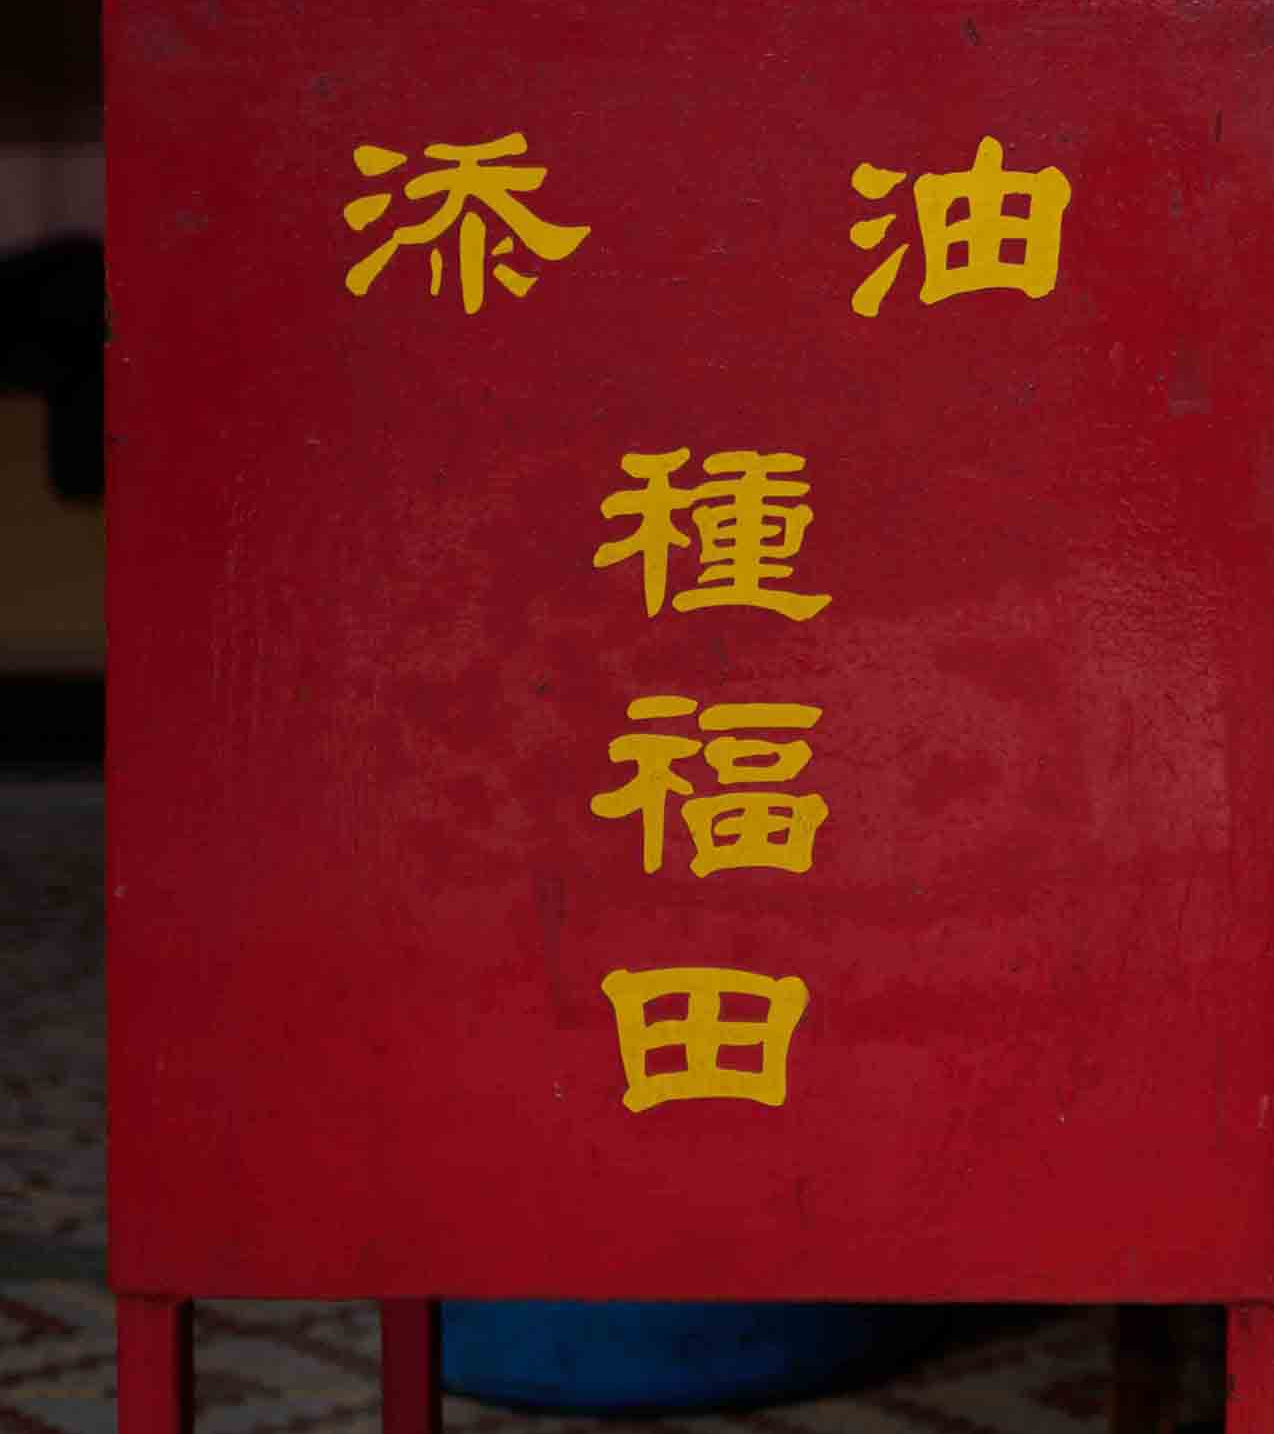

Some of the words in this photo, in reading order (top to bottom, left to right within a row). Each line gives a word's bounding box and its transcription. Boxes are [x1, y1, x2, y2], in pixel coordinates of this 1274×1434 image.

[343, 132, 1072, 317] 添油
[590, 446, 833, 1114] 種福田
